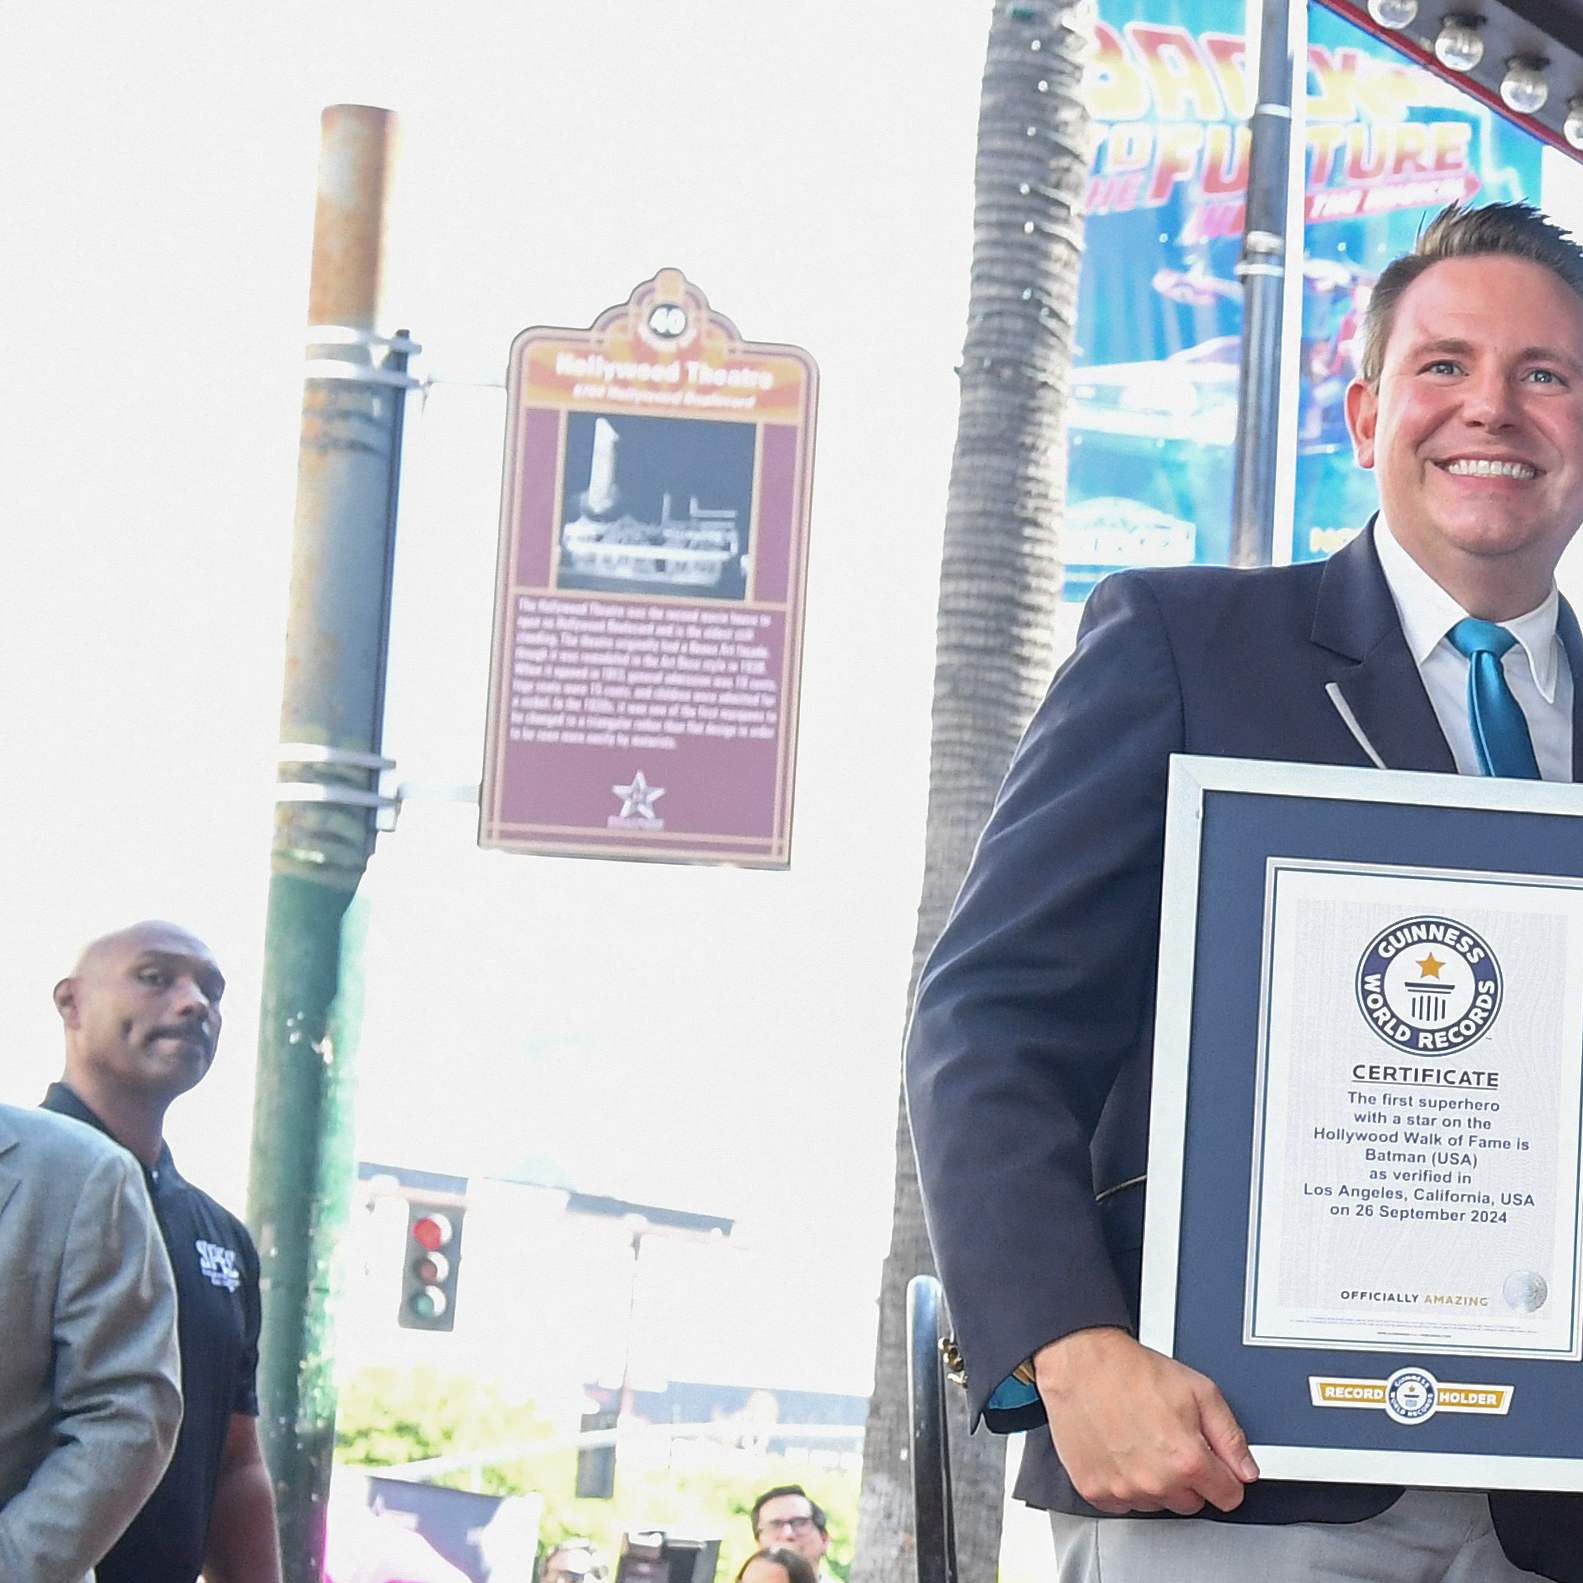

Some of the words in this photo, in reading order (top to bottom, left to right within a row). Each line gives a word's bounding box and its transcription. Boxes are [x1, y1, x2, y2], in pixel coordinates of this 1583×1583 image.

[556, 351, 680, 384] Hollywood
[1377, 923, 1485, 964] GUINNESS
[1364, 973, 1411, 1042] WORLD
[1418, 980, 1495, 1049] RECORDS
[1352, 1064, 1500, 1088] CERTIFICATE
[1347, 1091, 1377, 1105] The
[1382, 1093, 1414, 1107] first
[1419, 1096, 1501, 1113] superhero
[1353, 1111, 1387, 1125] with
[1392, 1115, 1401, 1125] a
[1407, 1114, 1438, 1127] star
[1441, 1118, 1462, 1129] on
[1467, 1117, 1492, 1130] the
[1313, 1127, 1399, 1145] Hollywood
[1403, 1131, 1442, 1146] Walk
[1447, 1134, 1464, 1147] of
[1468, 1136, 1511, 1150] Fame
[1517, 1138, 1530, 1150] is
[1365, 1148, 1427, 1164] Batman
[1431, 1152, 1478, 1168] (USA)
[1369, 1169, 1387, 1180] as
[1393, 1168, 1452, 1184] verified
[1457, 1171, 1472, 1185] in
[1303, 1182, 1333, 1197] Los
[1338, 1184, 1408, 1202] Angeles,
[1413, 1188, 1495, 1206] California,
[1500, 1192, 1536, 1207] USA
[1330, 1206, 1350, 1217] on
[1355, 1204, 1374, 1217] 26
[1379, 1205, 1466, 1223] September
[1470, 1209, 1508, 1224] 2024
[1340, 1290, 1420, 1304] OFFICIALLY
[1424, 1294, 1489, 1307] AMAZING
[1325, 1386, 1384, 1400] RECORD
[1439, 1391, 1497, 1405] HOLDER
